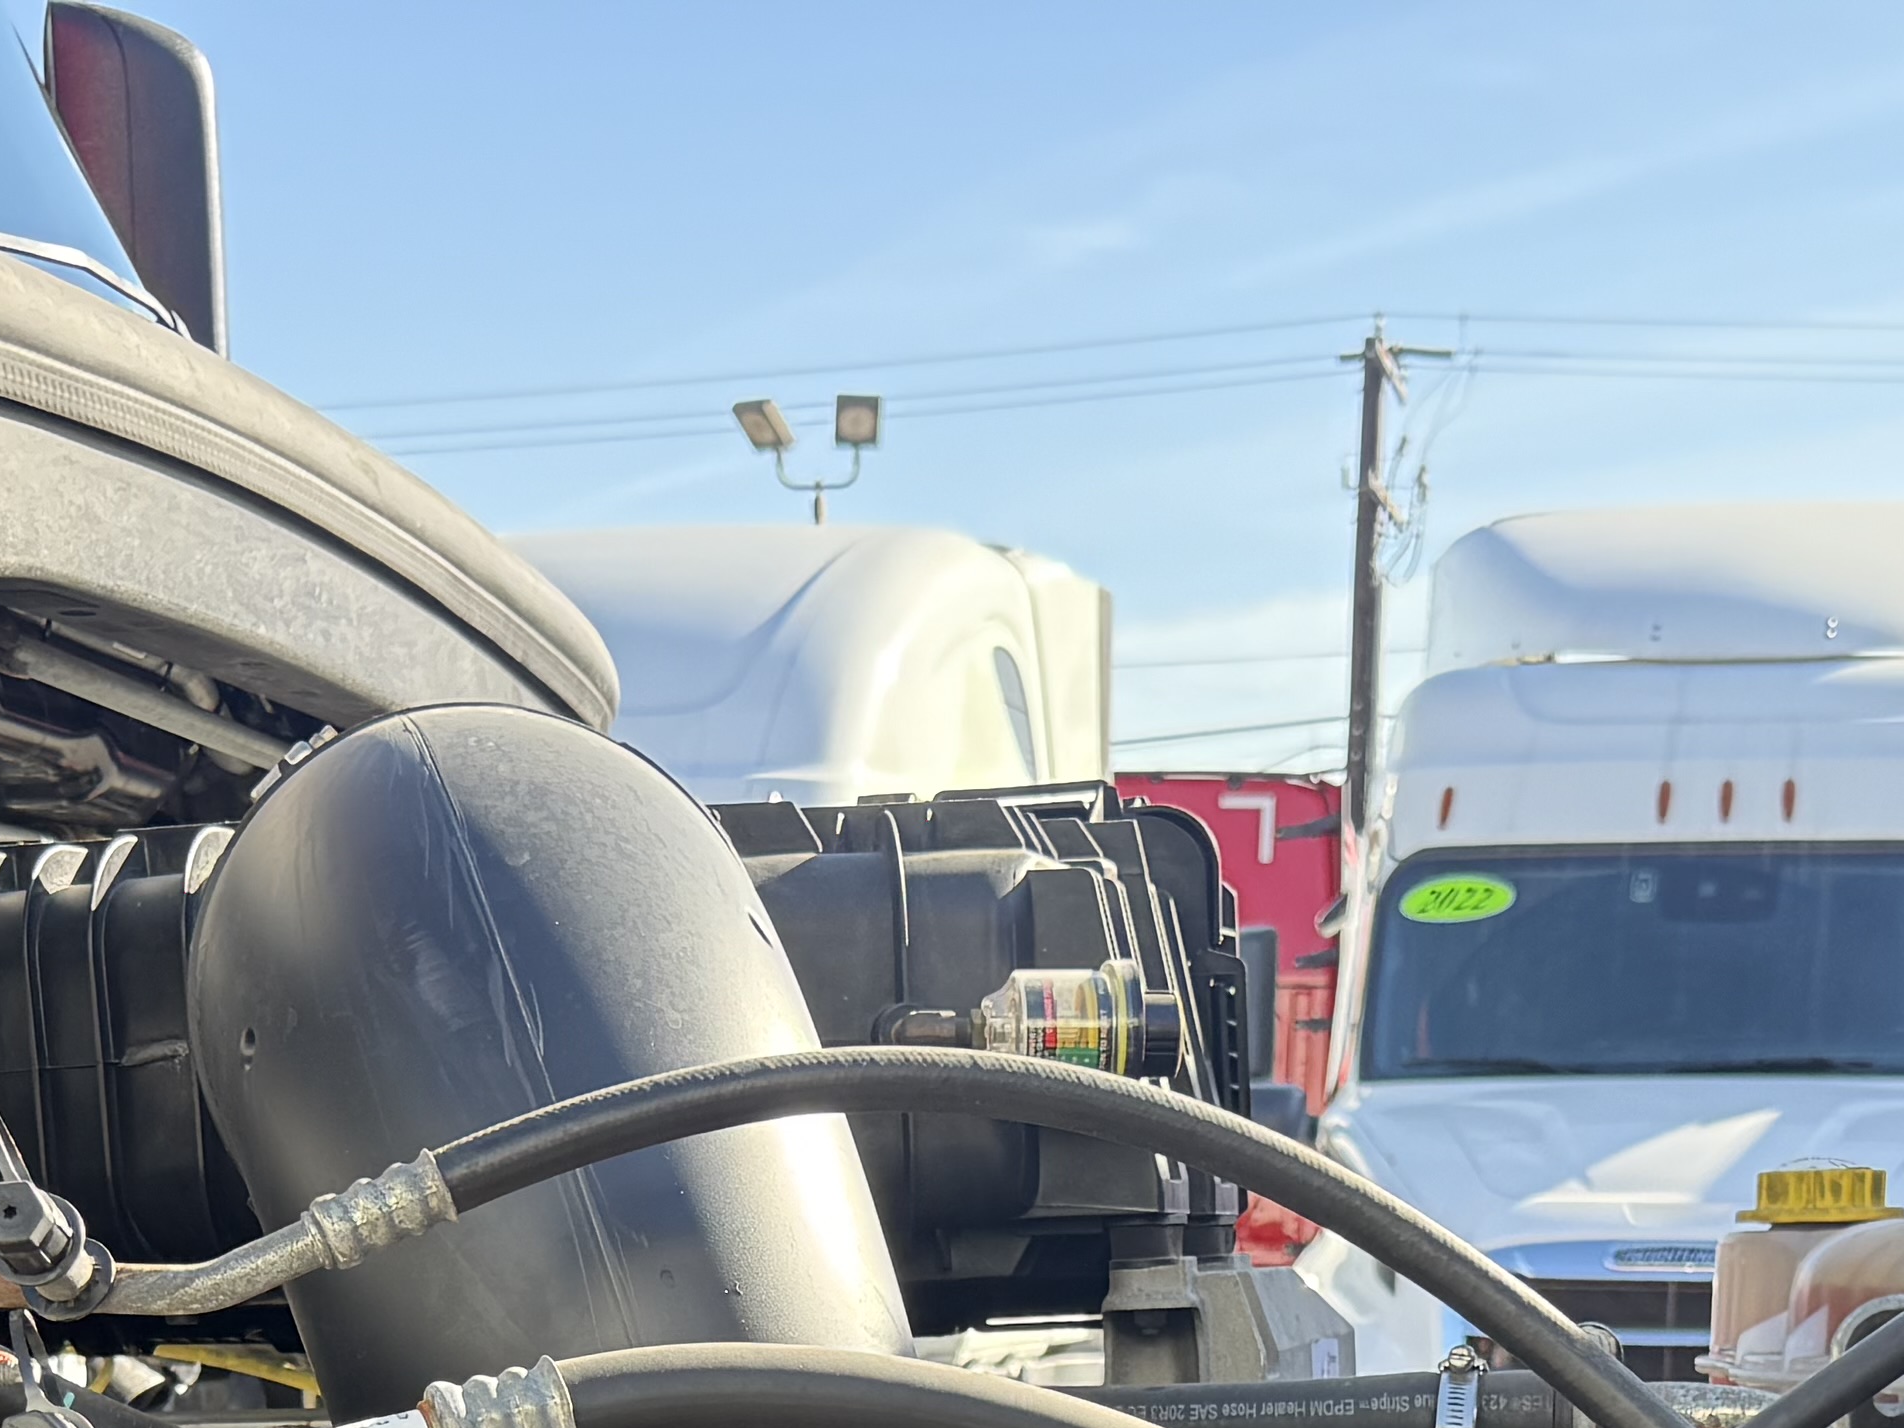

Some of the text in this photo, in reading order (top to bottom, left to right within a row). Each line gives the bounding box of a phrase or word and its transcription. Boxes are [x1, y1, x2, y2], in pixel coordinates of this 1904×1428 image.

[1416, 887, 1494, 914] 2022
[1188, 1403, 1219, 1421] SAE
[1221, 1401, 1258, 1420] Hose
[1260, 1399, 1306, 1419] Heater
[1309, 1398, 1355, 1416] EPDM
